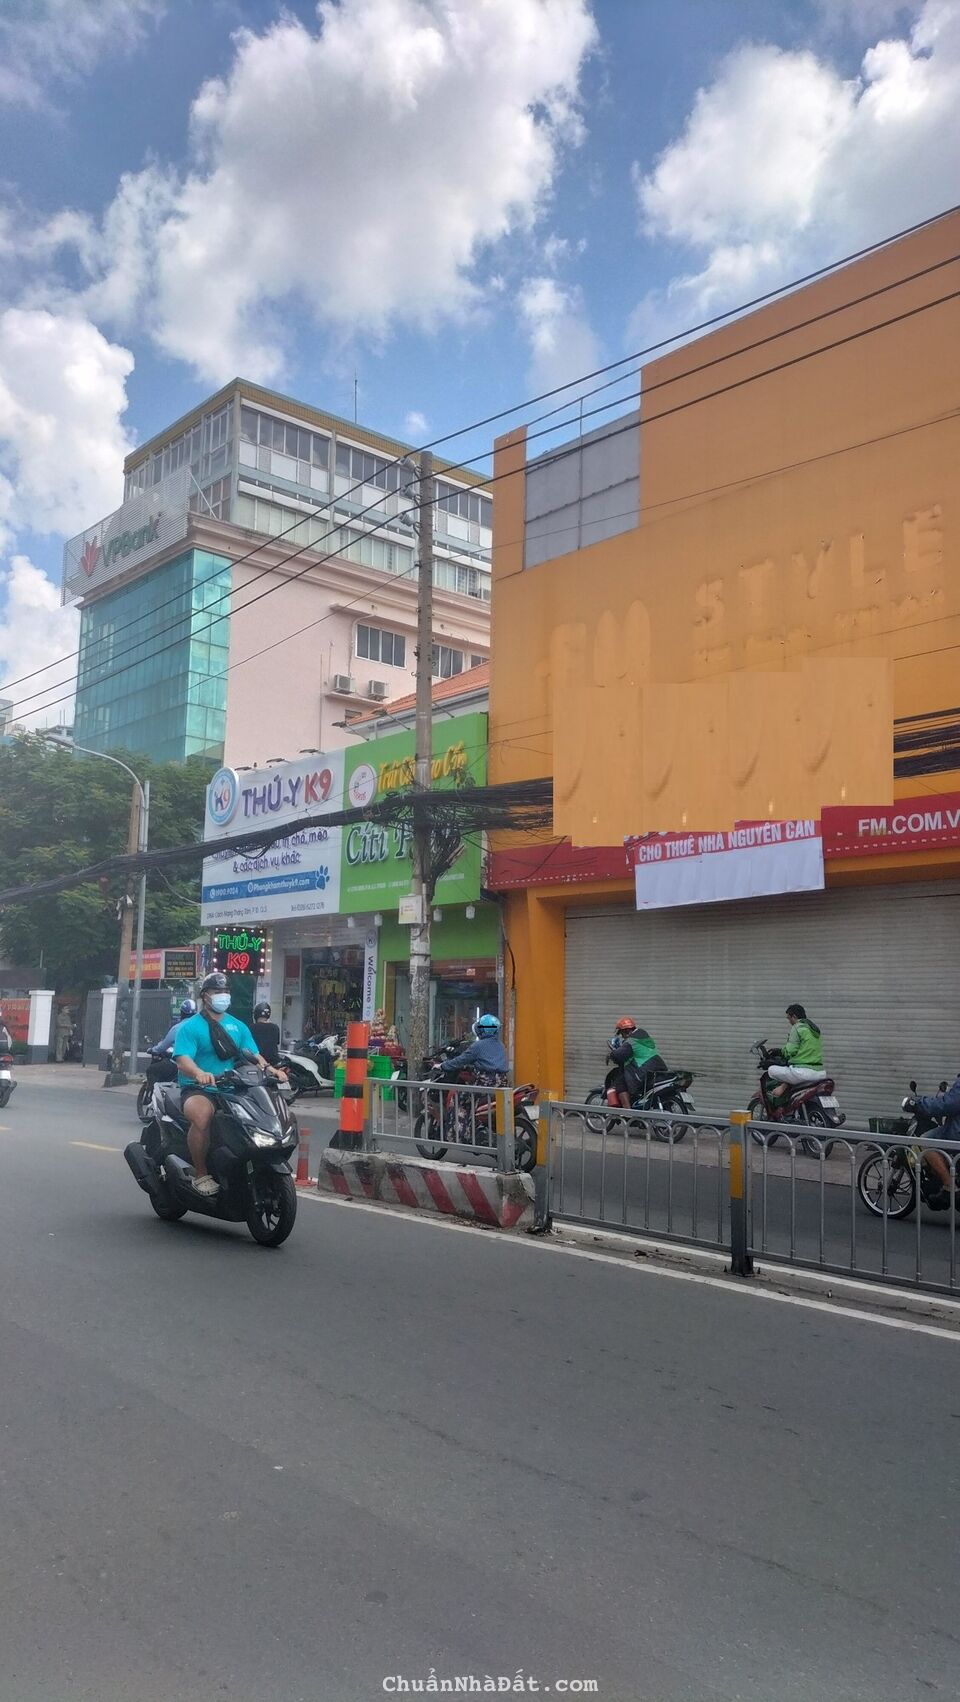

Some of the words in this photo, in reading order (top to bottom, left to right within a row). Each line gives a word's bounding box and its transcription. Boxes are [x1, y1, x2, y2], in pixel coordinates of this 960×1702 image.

[304, 768, 334, 805] K9
[638, 842, 662, 862] CHO
[664, 834, 694, 858] THUÊ
[697, 831, 725, 853] NHÀ
[727, 822, 782, 849] NGUYÊN
[217, 932, 262, 952] THÚ-Y
[226, 951, 250, 970] K9
